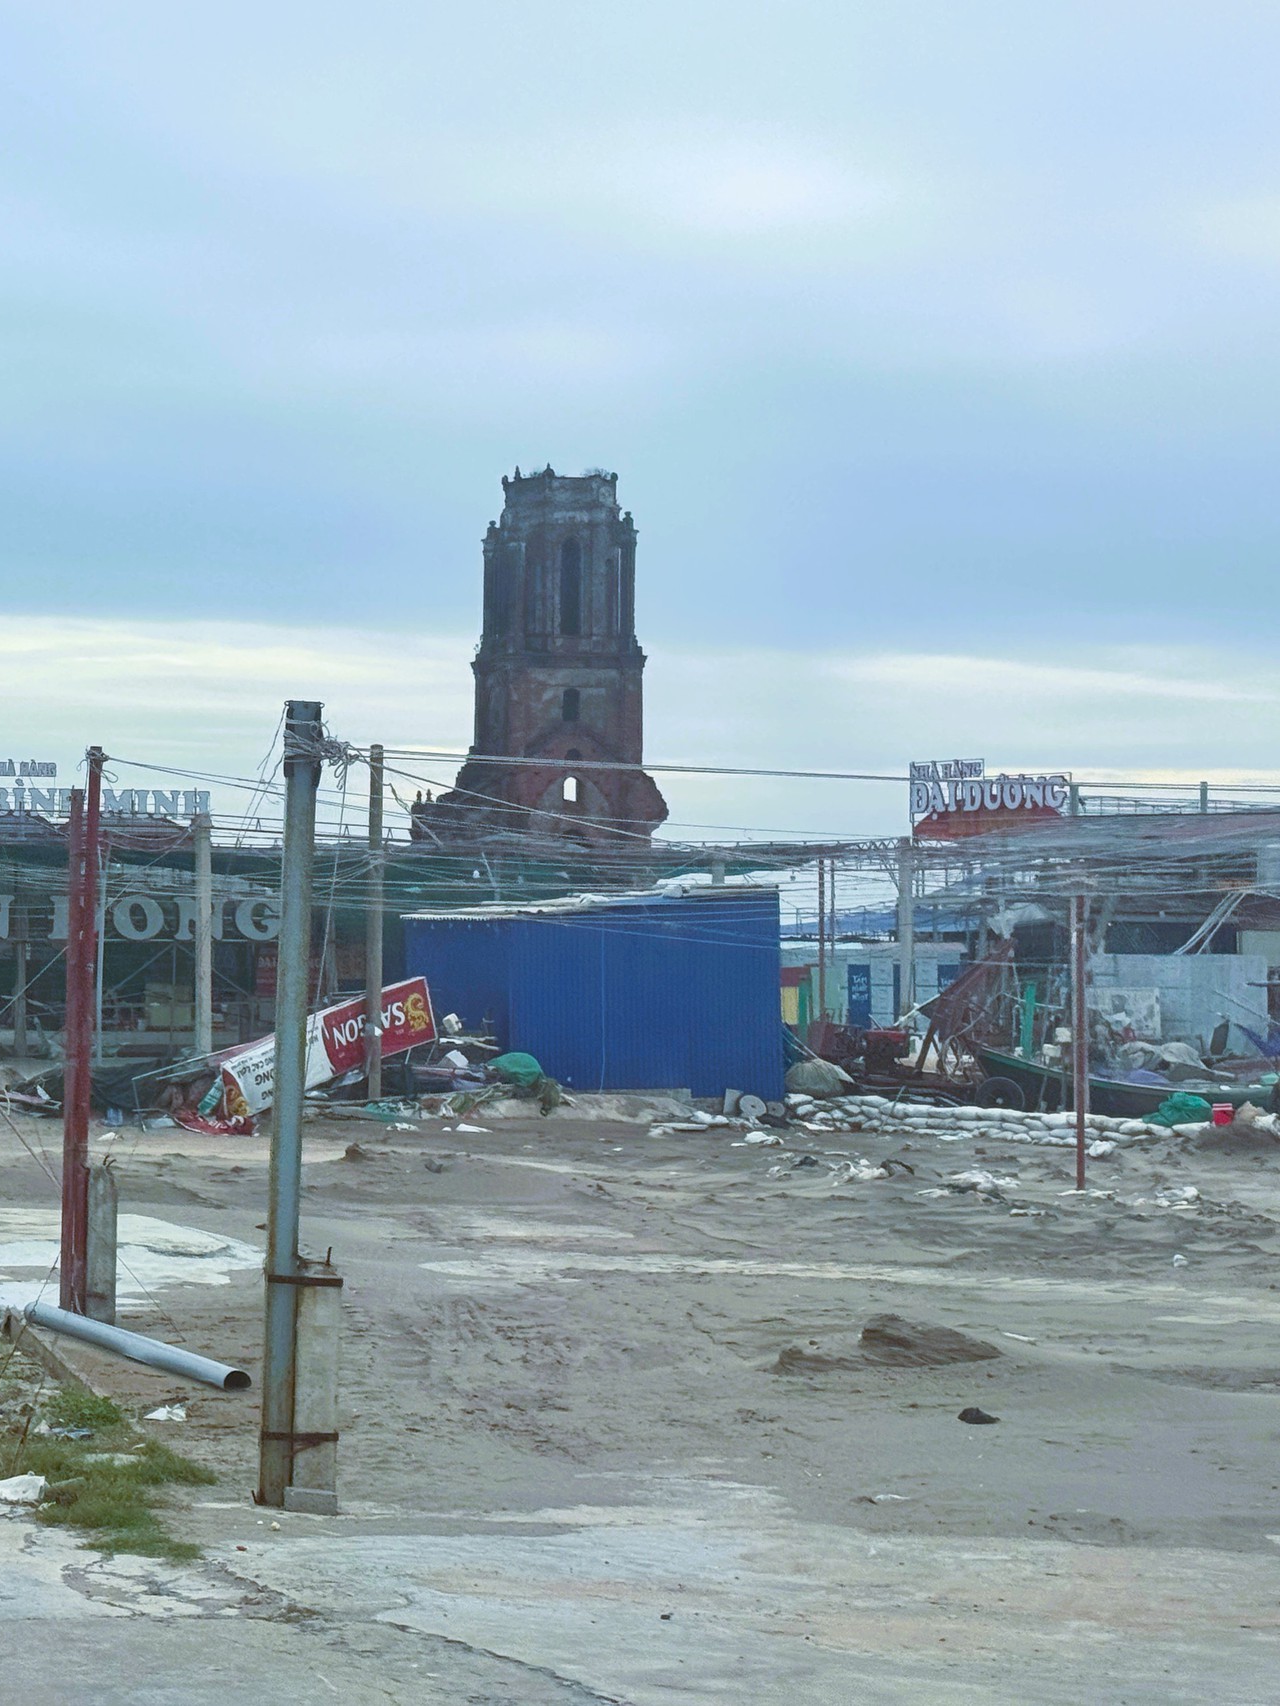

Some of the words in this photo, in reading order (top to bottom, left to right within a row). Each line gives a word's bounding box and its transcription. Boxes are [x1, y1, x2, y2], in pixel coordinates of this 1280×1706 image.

[20, 759, 57, 777] HÀNG
[101, 788, 211, 816] MINH
[332, 1001, 407, 1050] SAGON
